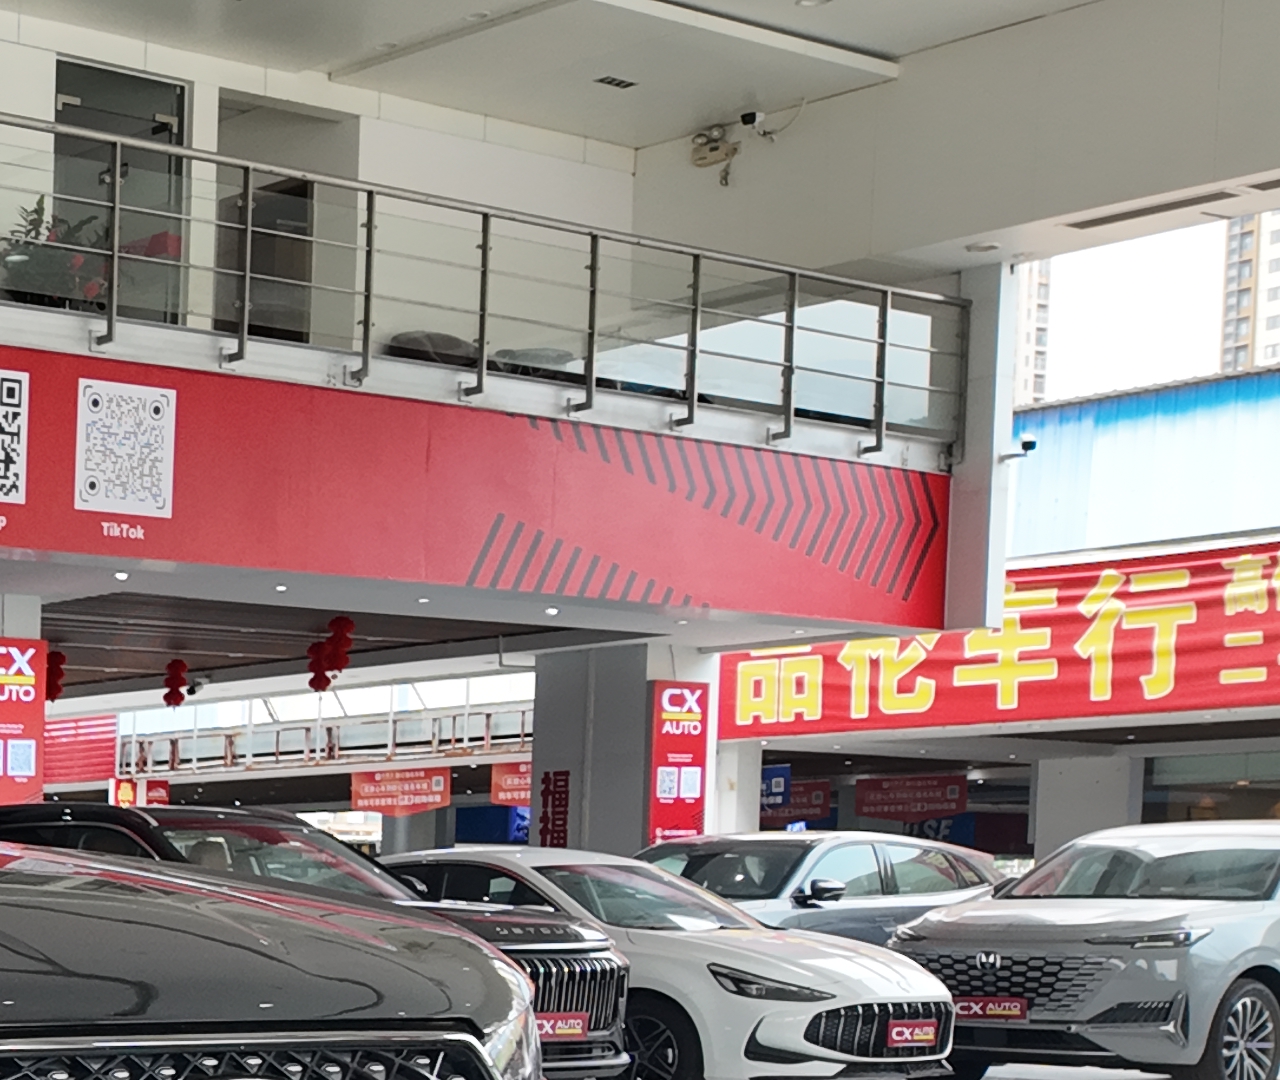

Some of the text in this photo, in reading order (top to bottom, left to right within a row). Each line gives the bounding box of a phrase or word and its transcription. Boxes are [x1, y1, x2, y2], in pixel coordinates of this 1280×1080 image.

[101, 522, 145, 540] TikTok
[661, 688, 702, 713] CX
[661, 721, 702, 735] AUTO
[955, 1002, 1021, 1014] CX AUTO
[556, 1019, 583, 1029] AUTO
[891, 1026, 913, 1040] CX
